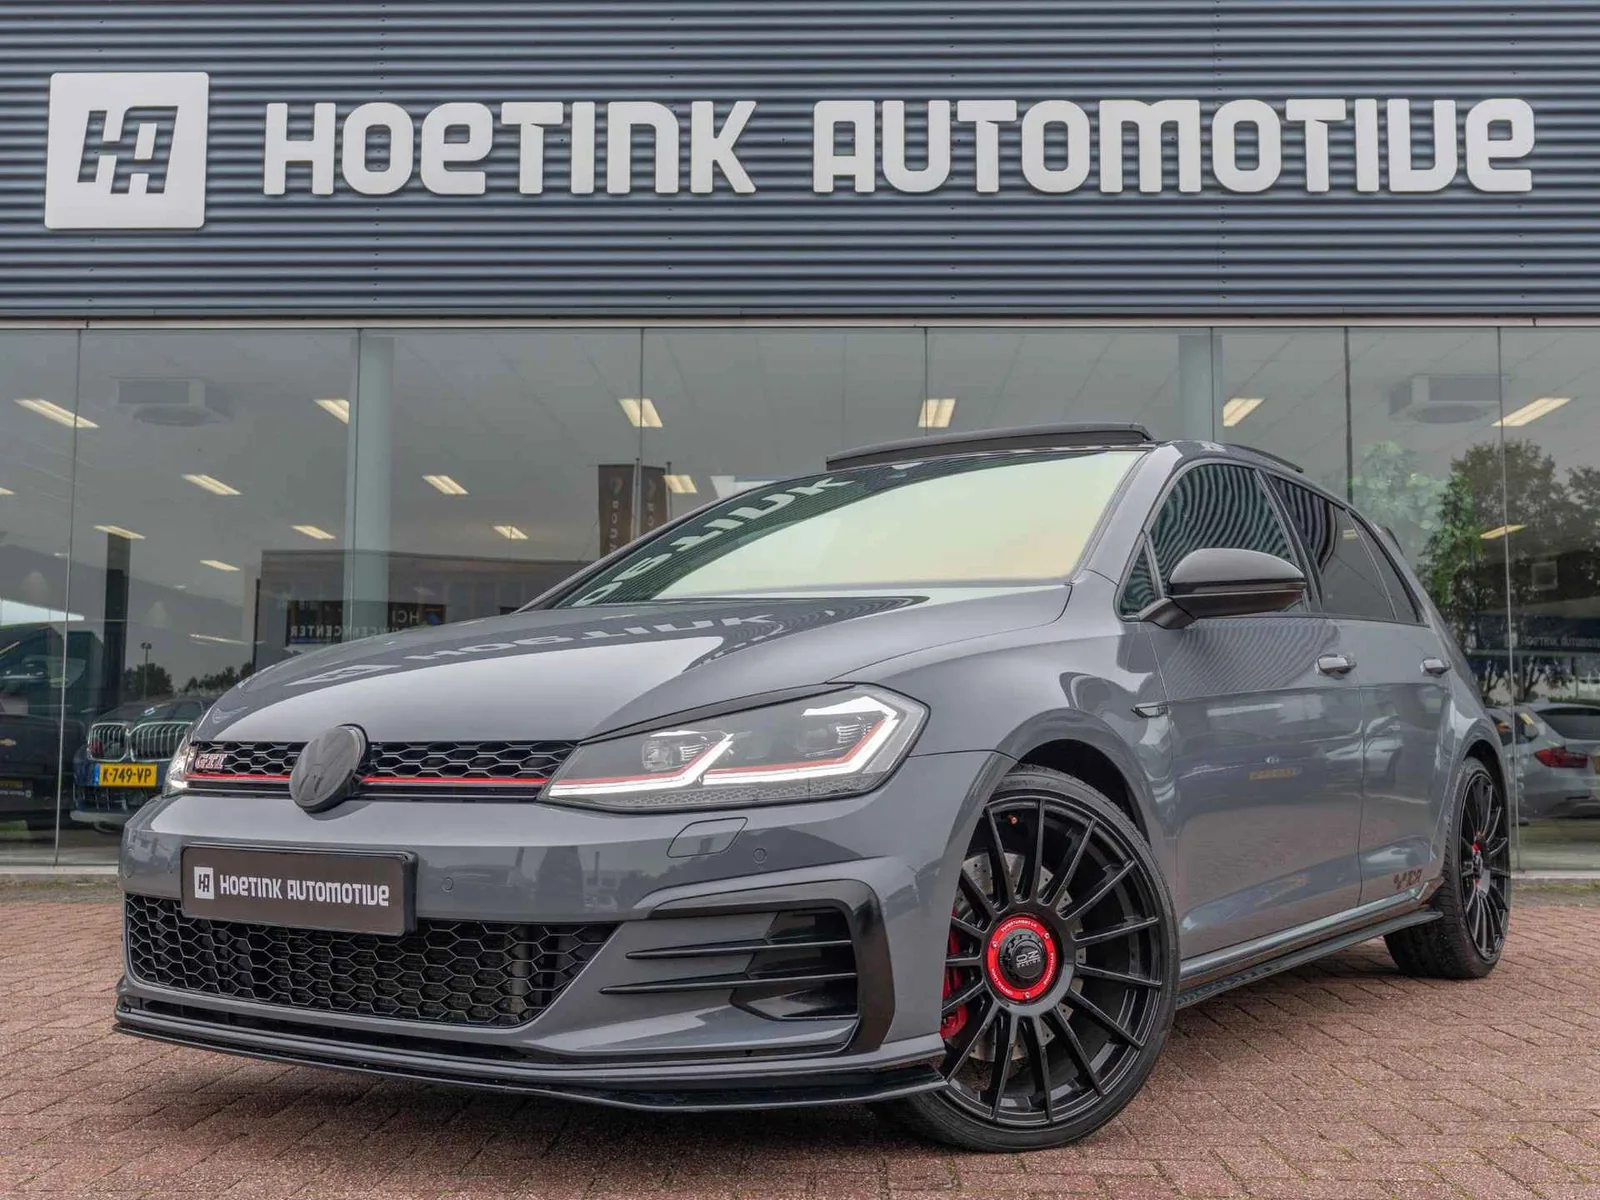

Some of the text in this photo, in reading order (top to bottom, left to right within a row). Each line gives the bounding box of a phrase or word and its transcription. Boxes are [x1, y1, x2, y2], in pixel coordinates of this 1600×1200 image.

[263, 98, 1536, 195] HOETINK AUTOMOTIVE
[195, 753, 228, 770] GTI
[102, 764, 152, 782] K-749-VP
[219, 874, 283, 899] HOETINK
[287, 879, 390, 907] AUTOMOTIVE
[1016, 950, 1040, 963] OZ
